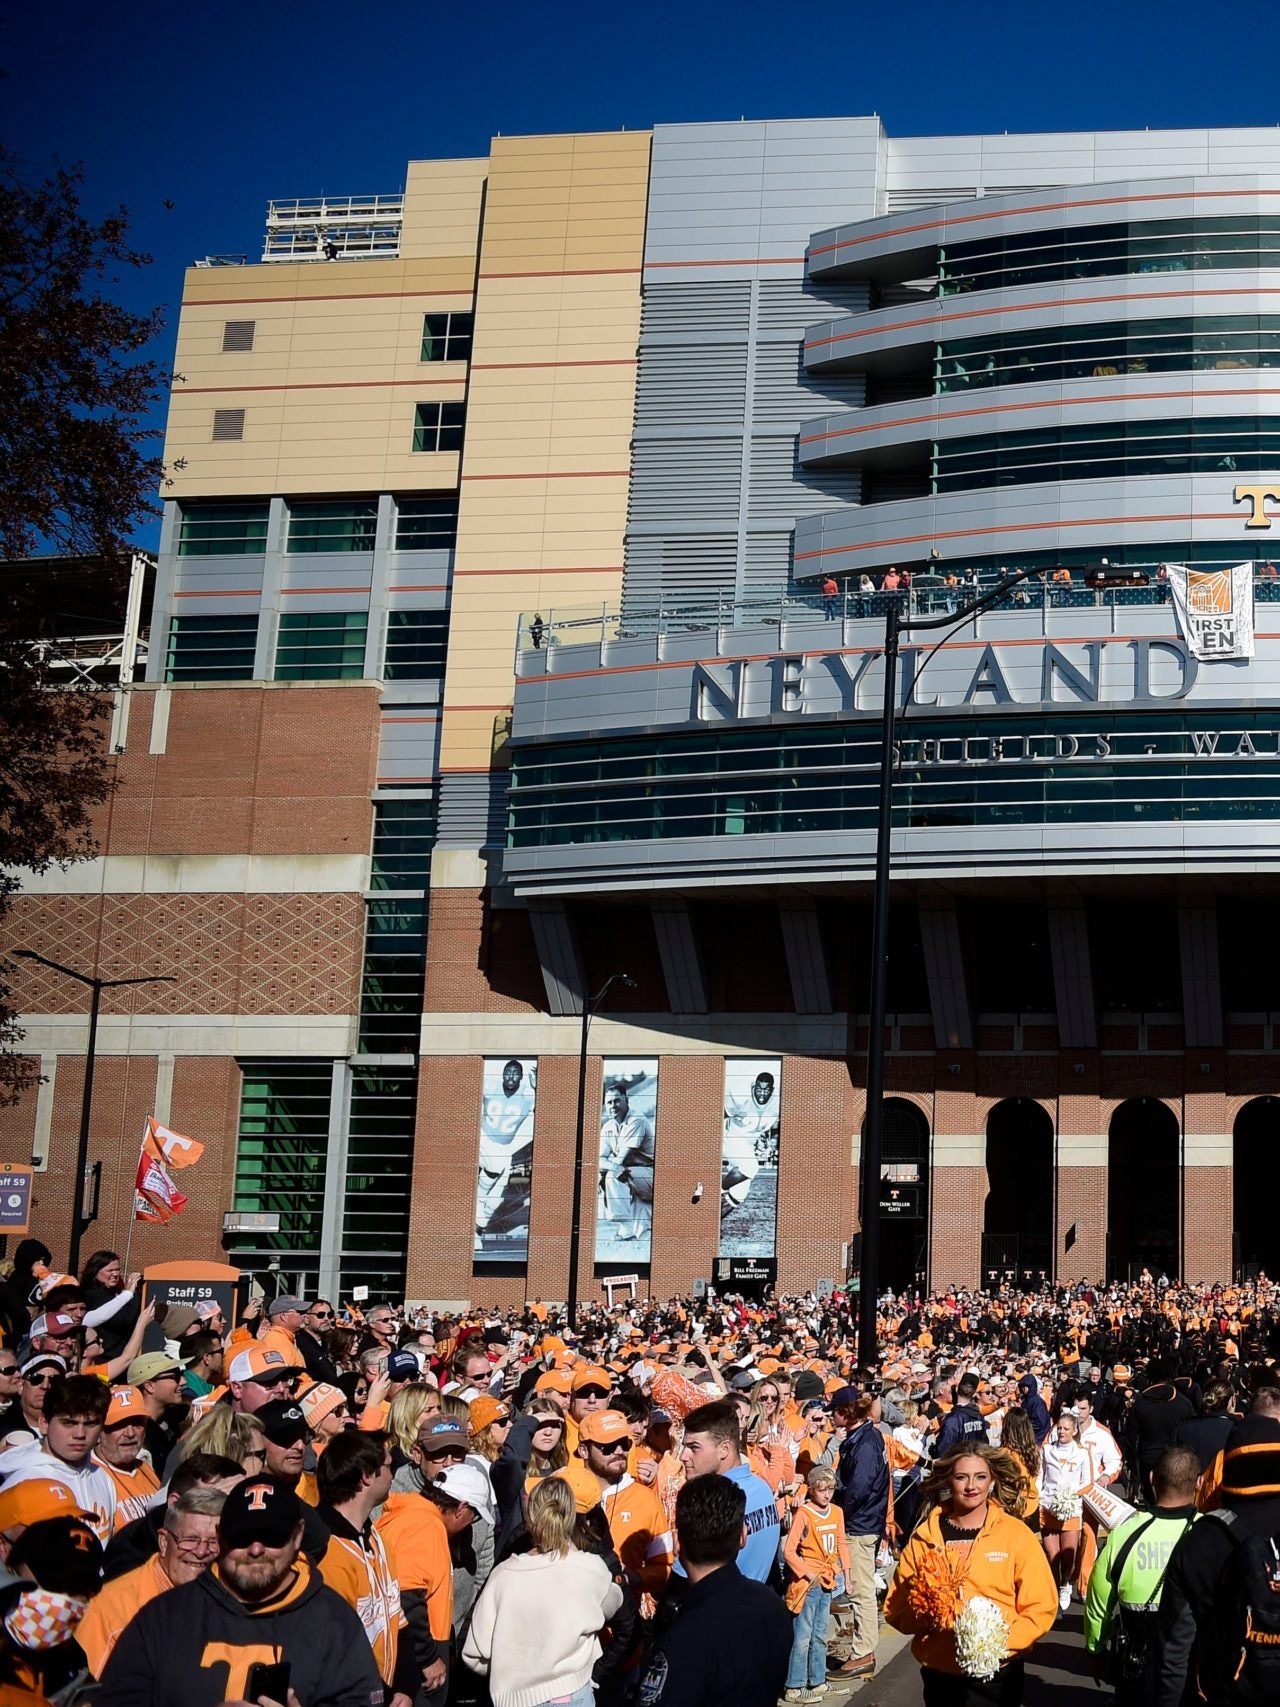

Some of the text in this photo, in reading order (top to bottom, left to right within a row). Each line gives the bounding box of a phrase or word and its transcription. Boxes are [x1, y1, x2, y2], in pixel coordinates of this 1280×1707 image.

[1192, 619, 1233, 631] IRST
[1198, 632, 1235, 648] EN
[692, 638, 1199, 721] NEYLAND
[485, 1102, 523, 1133] 92
[154, 1125, 193, 1161] T
[13, 1178, 26, 1186] S9
[890, 1190, 900, 1199] T
[747, 1258, 757, 1268] T
[168, 1287, 213, 1298] Staff S9
[114, 1389, 133, 1407] T
[49, 1486, 67, 1500] T
[244, 1484, 274, 1511] T
[1089, 1489, 1118, 1518] TENN
[620, 1511, 631, 1523] T
[69, 1528, 94, 1551] T
[821, 1533, 836, 1554] 10
[1137, 1541, 1176, 1571] SHE
[200, 1642, 283, 1703] T
